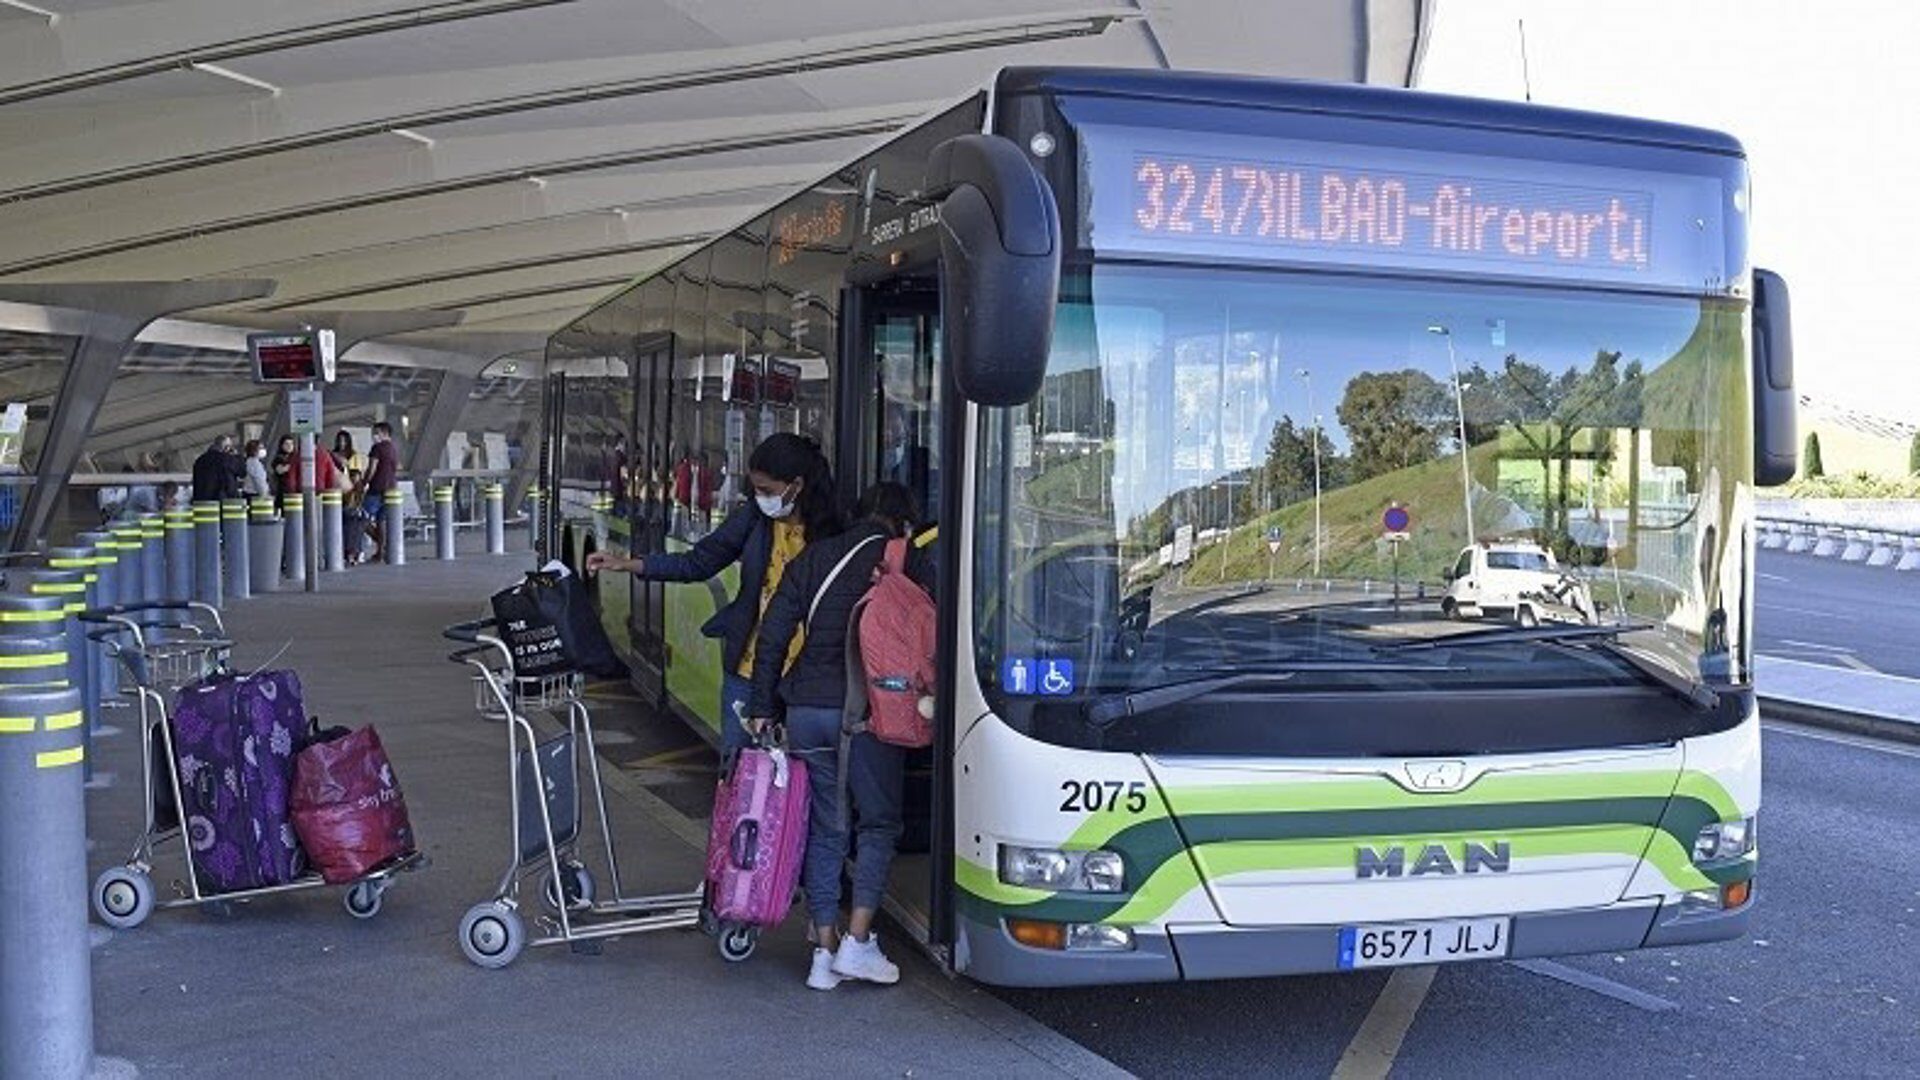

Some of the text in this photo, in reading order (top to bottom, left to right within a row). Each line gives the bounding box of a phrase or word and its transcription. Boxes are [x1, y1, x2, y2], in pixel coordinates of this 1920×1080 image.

[1059, 780, 1147, 814] 2075
[1355, 841, 1511, 878] MAN
[1361, 923, 1501, 959] 6571 JLJ
